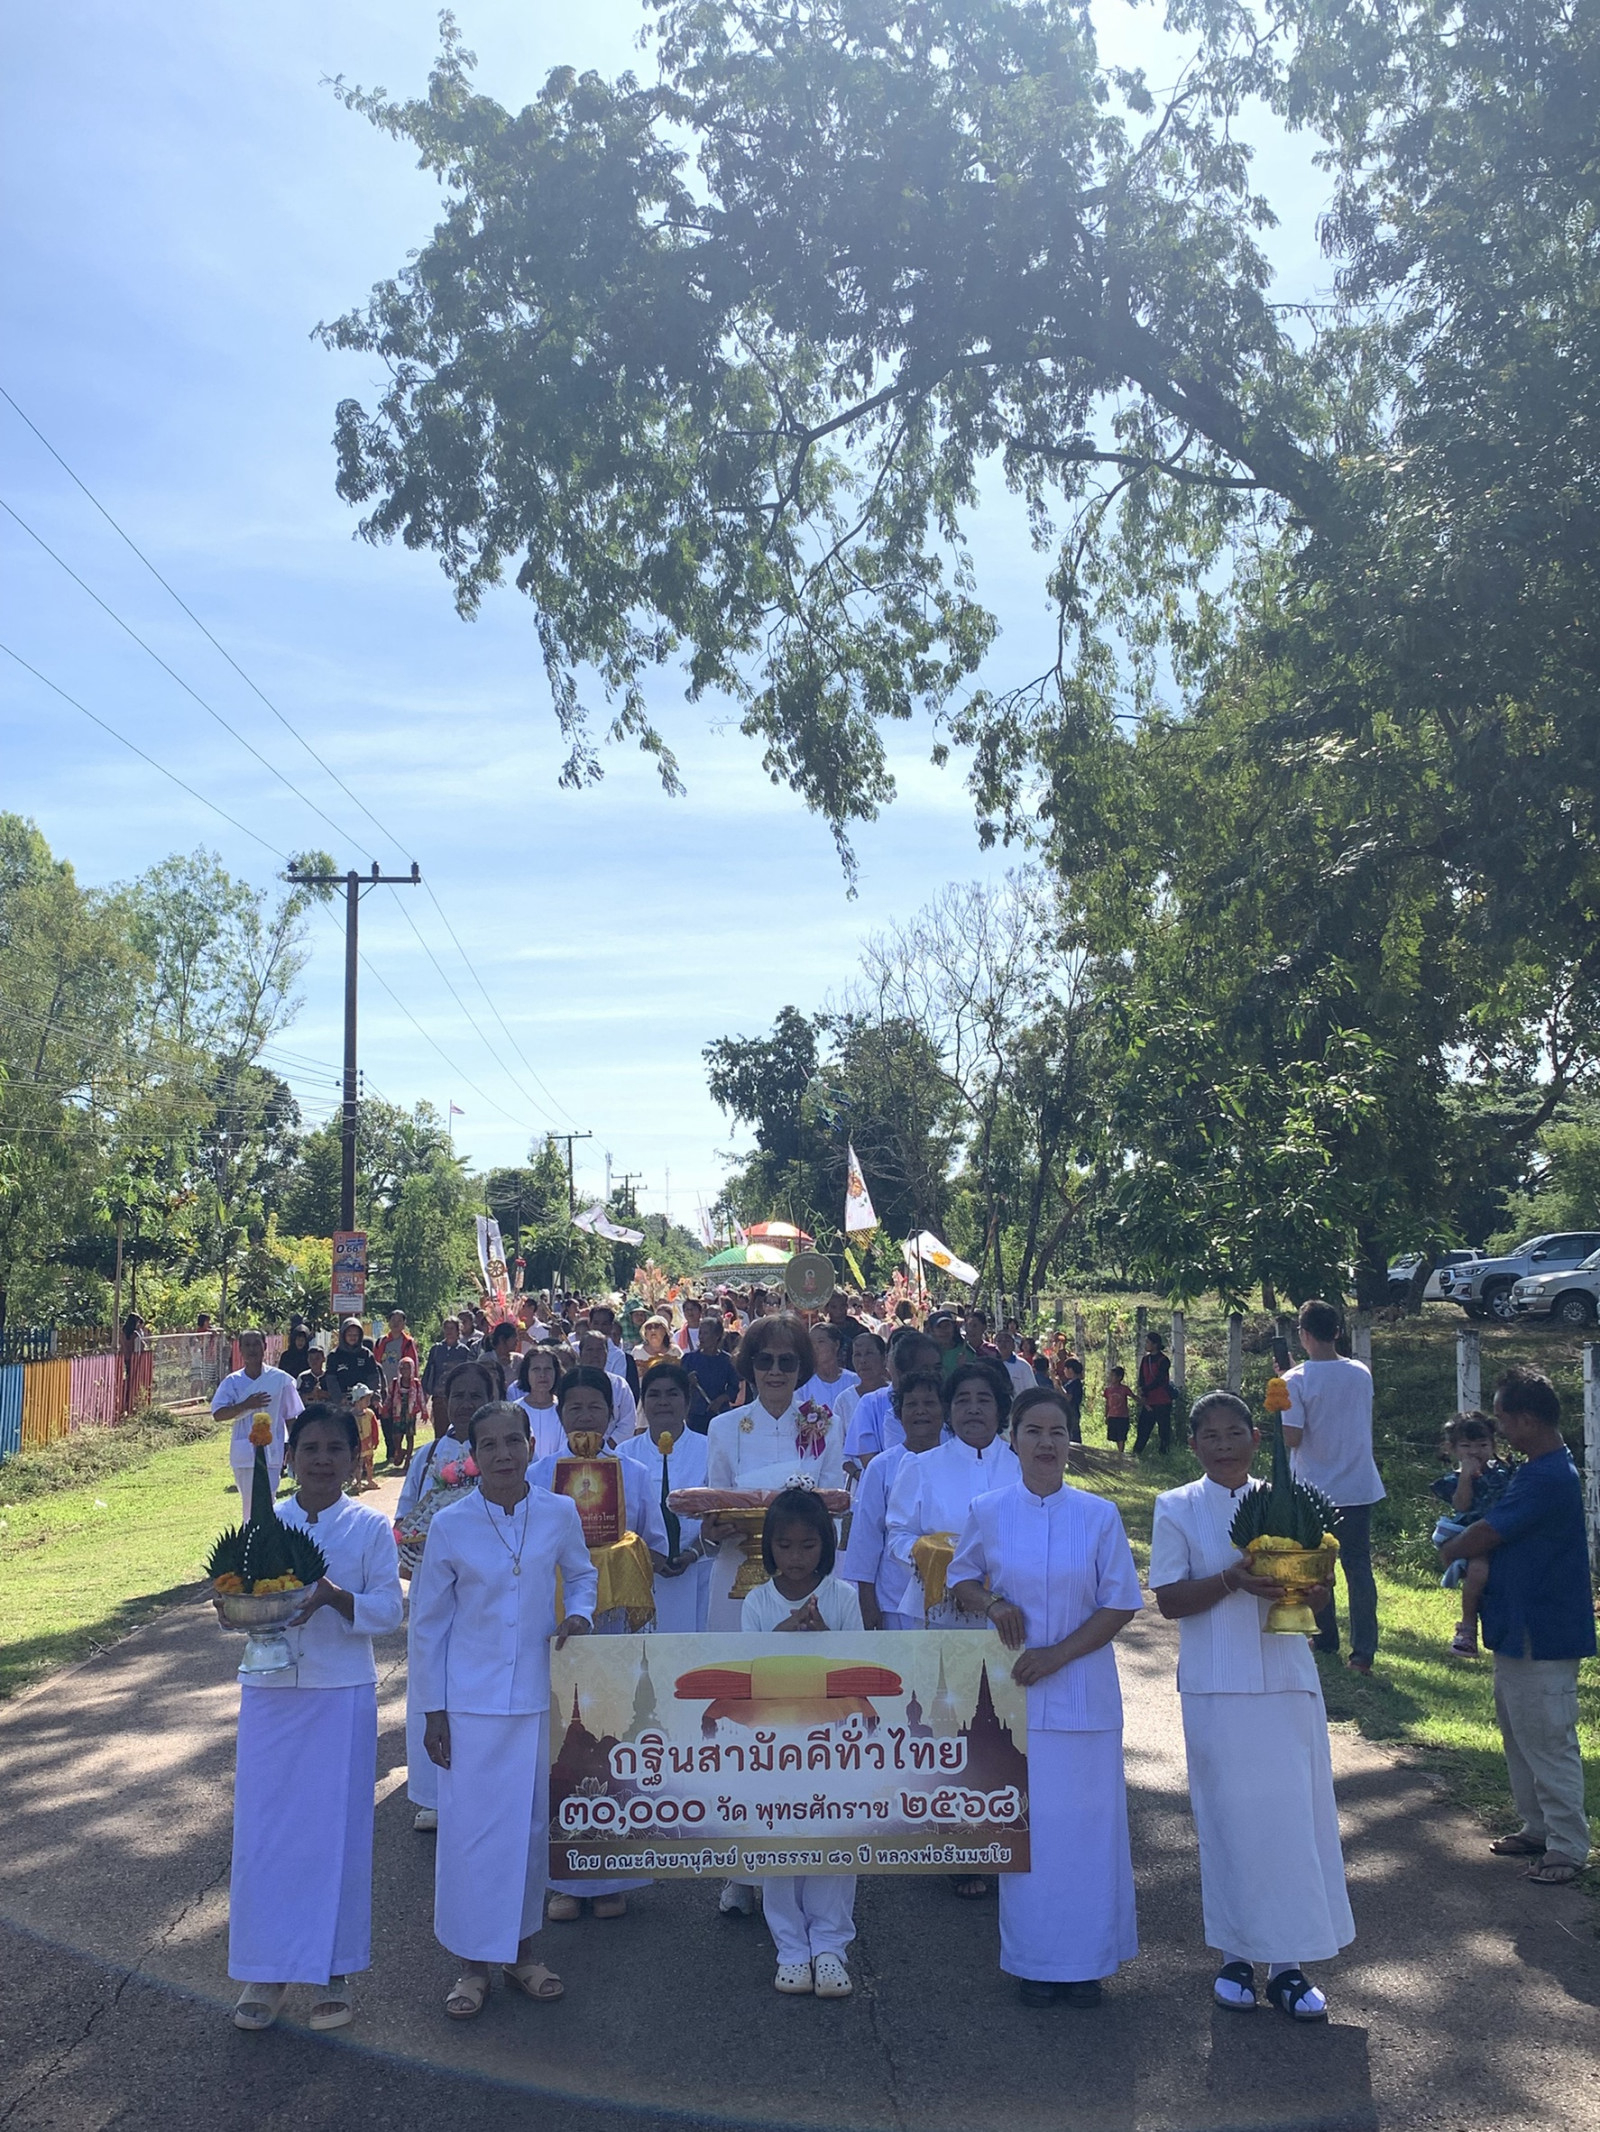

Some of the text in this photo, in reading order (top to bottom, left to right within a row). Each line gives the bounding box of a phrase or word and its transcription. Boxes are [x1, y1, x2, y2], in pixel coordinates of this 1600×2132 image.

[613, 1718, 963, 1787] กฐินสามัคคีทั่วไทย
[563, 1790, 1015, 1829] ๓๐,๐๐๐ วัด พุทธศักราช ๒๕๖๘
[567, 1843, 1012, 1873] โดย คณะศิษยานุศิษย์ บูชาธรรม ๘๑ ปี หลวงพ่อธัมมชโย
